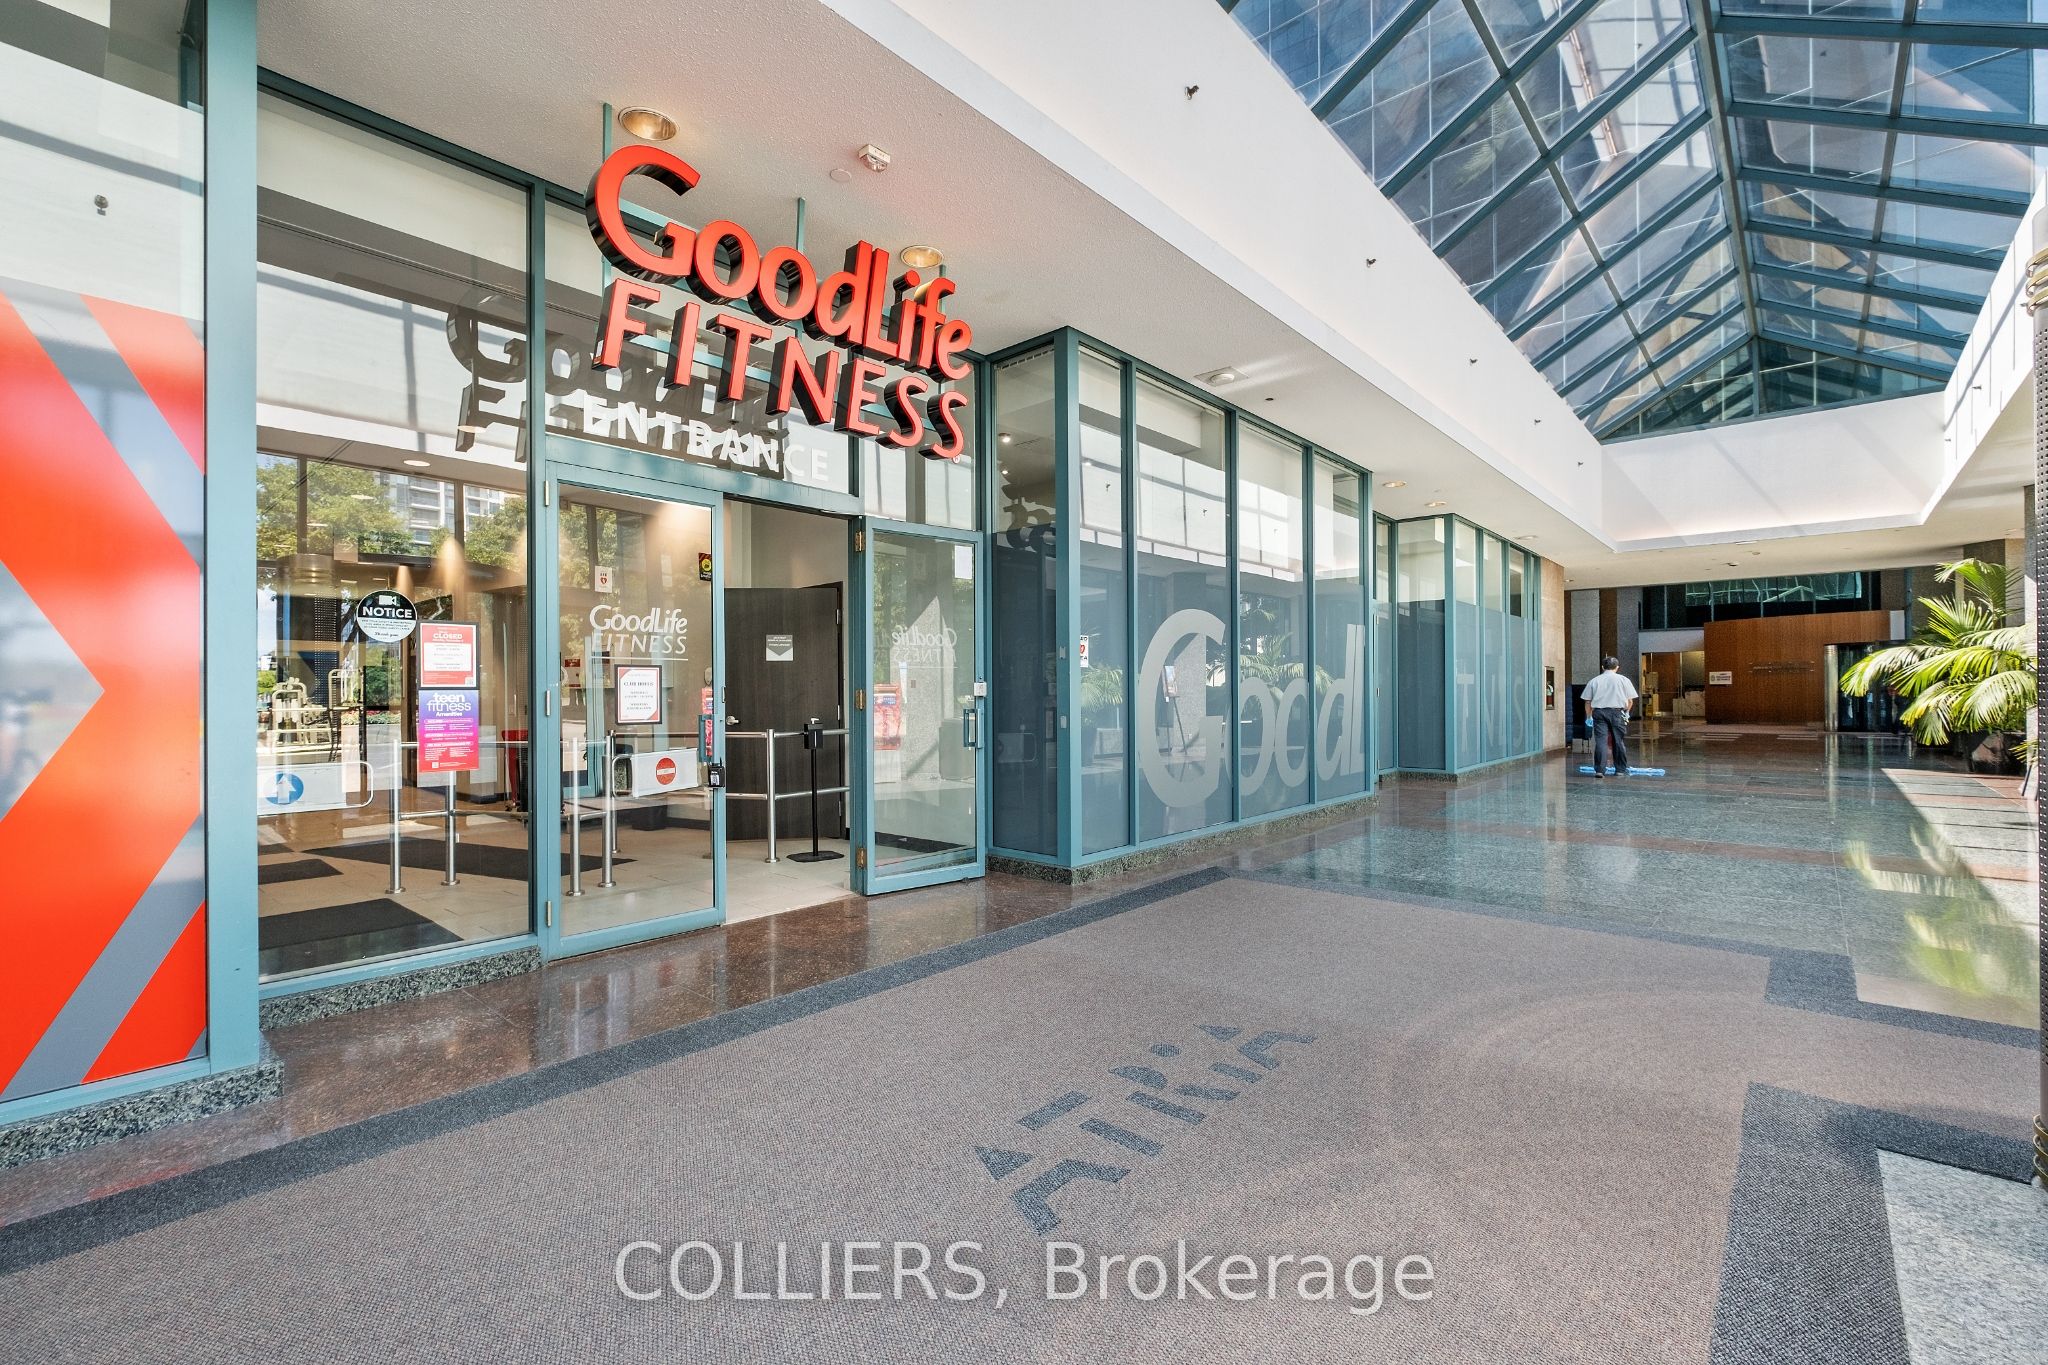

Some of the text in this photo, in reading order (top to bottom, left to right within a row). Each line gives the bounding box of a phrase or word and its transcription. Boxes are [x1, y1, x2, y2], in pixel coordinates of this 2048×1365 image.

[587, 144, 972, 382] GoodLife
[592, 278, 968, 461] FITNESS
[583, 393, 829, 482] ENTRANCE
[362, 606, 413, 618] NOTICE
[589, 604, 688, 634] GoodLife
[591, 633, 687, 654] FITNESS
[426, 700, 472, 712] fitness
[432, 692, 466, 703] teen
